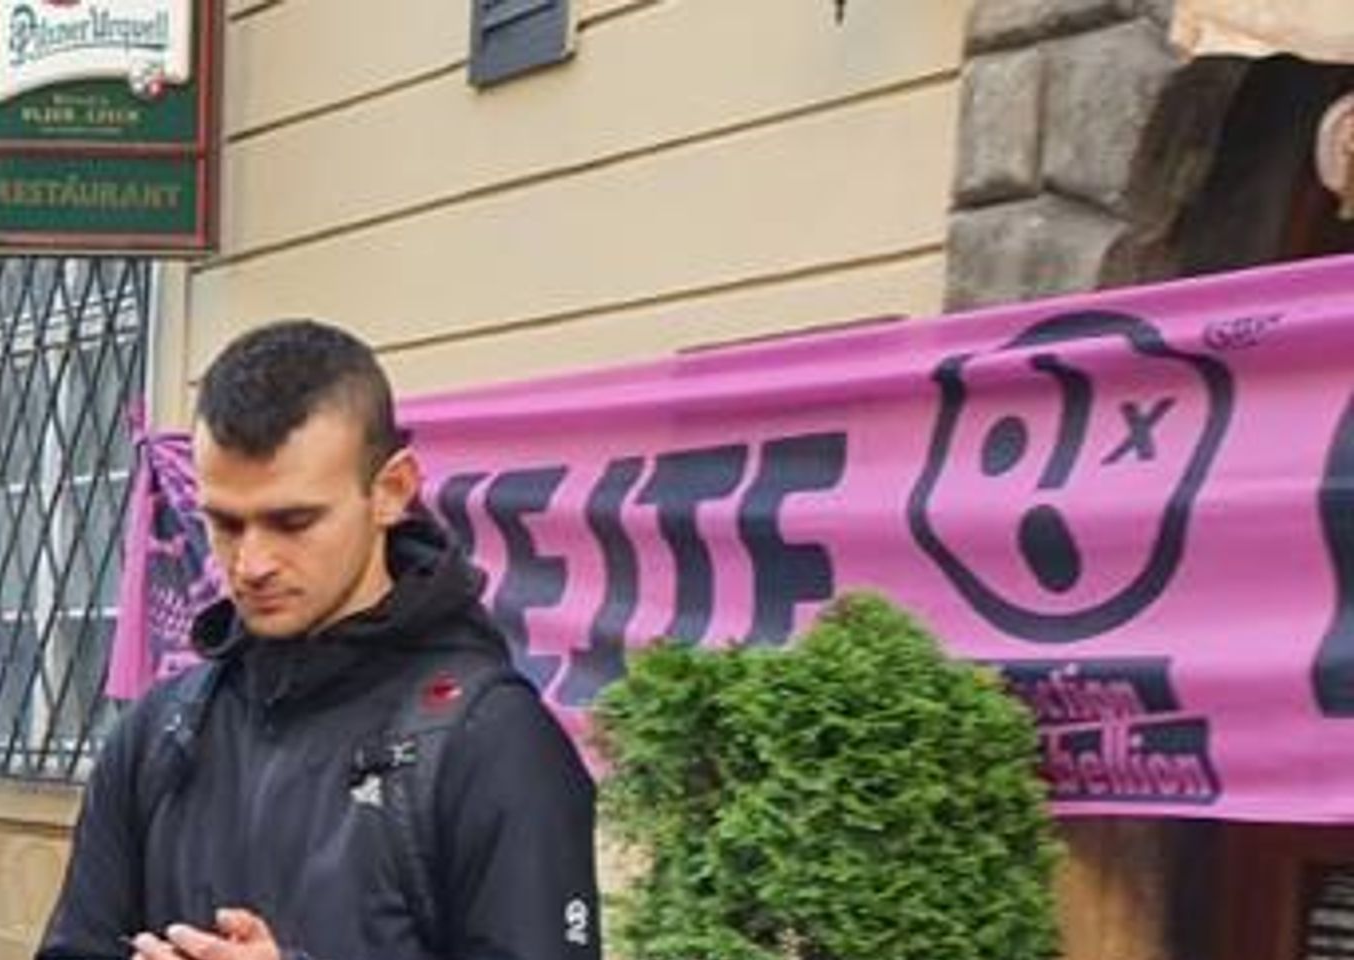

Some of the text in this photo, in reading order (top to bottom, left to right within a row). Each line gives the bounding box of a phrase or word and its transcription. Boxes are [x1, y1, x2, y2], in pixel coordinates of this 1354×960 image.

[91, 7, 170, 53] Urquell
[1036, 663, 1146, 718] ction
[1049, 726, 1212, 796] bellion
